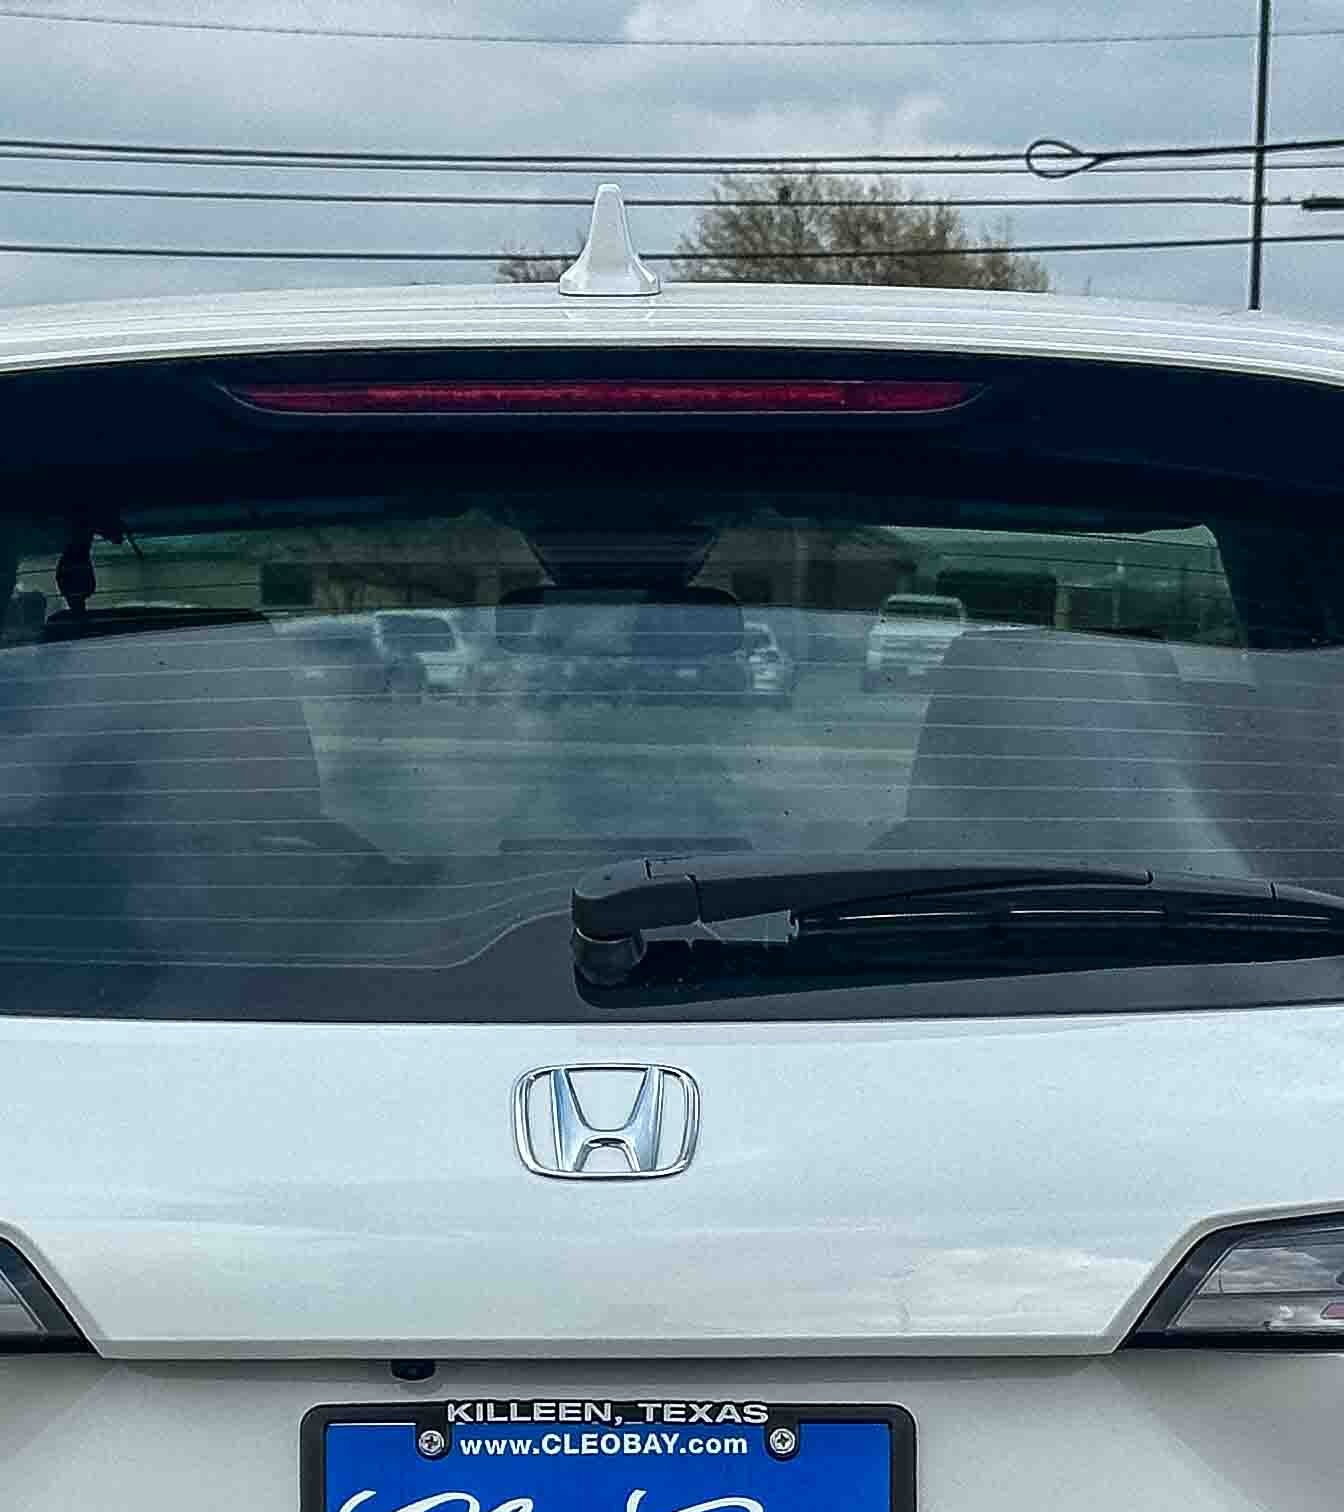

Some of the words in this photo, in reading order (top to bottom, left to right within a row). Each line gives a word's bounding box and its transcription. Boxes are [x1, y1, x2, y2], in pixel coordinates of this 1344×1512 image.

[447, 1402, 622, 1425] KILLEEN,
[638, 1403, 769, 1423] TEXAS
[460, 1433, 748, 1455] www.CLEOBAY.com
